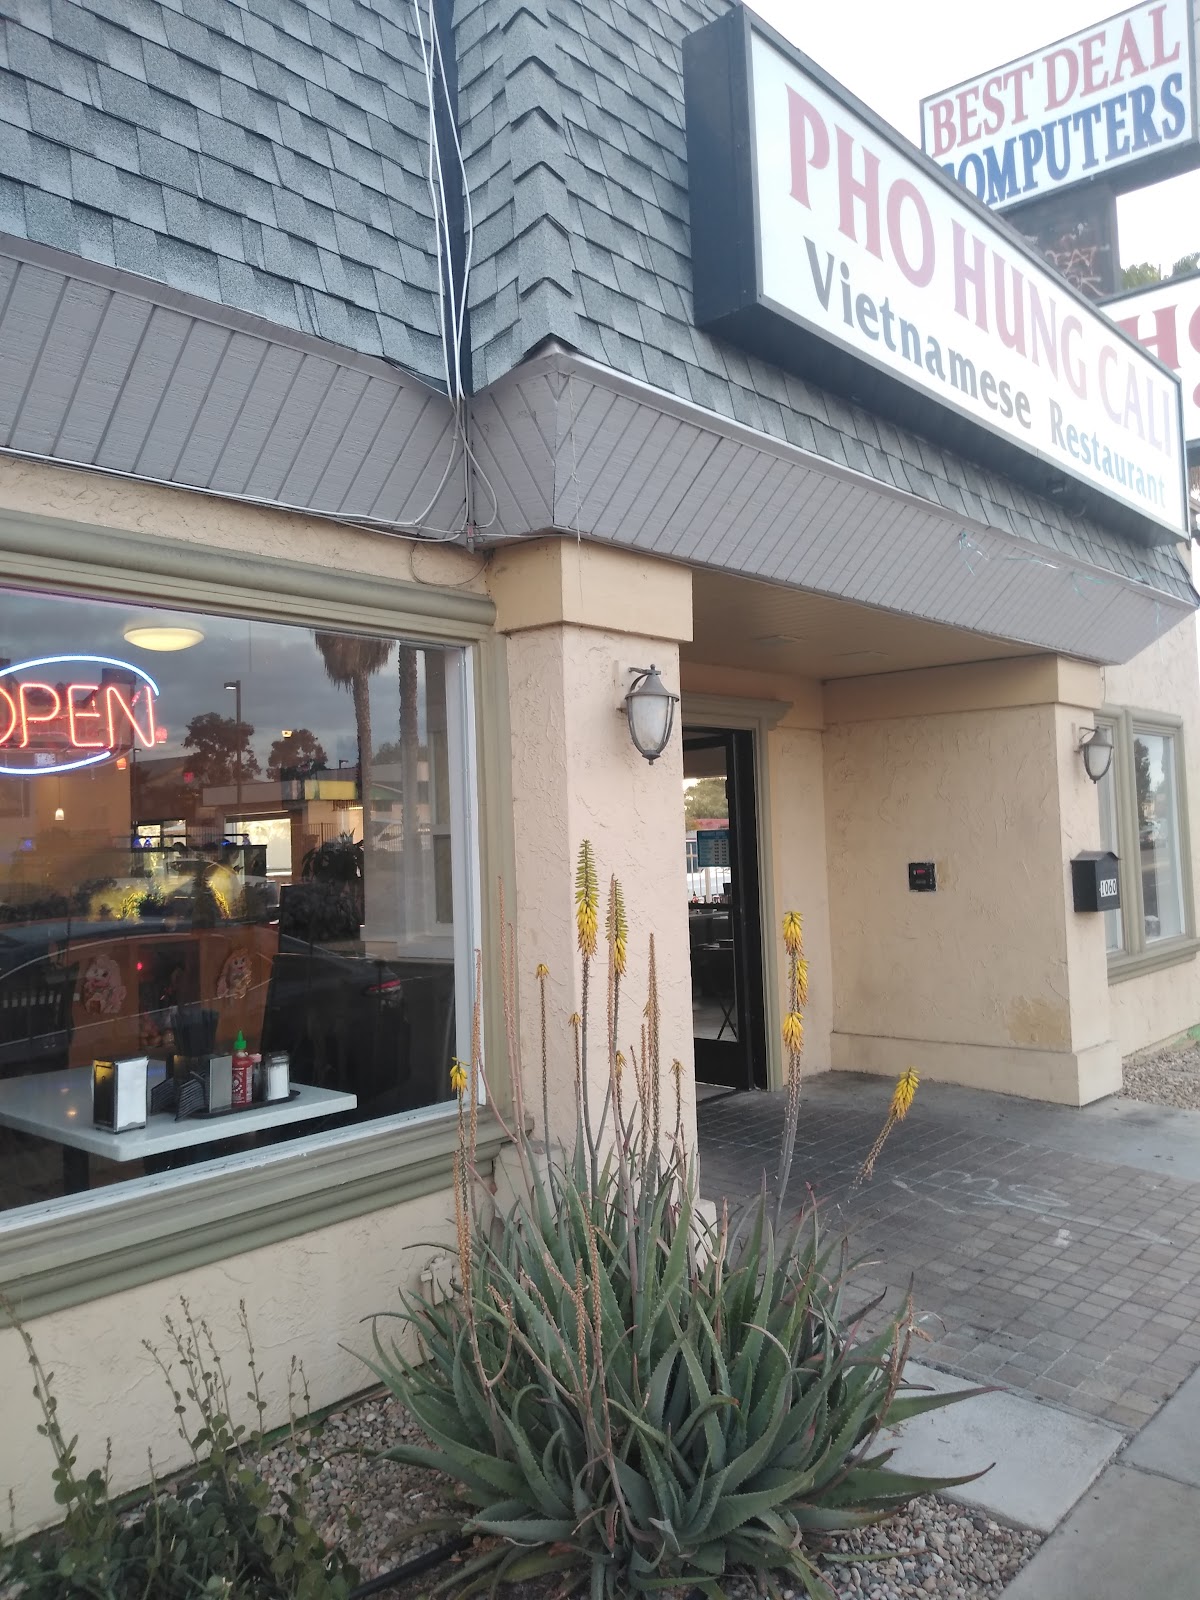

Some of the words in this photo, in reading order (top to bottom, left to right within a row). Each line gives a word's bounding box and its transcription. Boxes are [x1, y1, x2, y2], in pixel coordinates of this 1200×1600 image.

[928, 63, 1034, 158] BEST
[1041, 3, 1181, 112] DEAL
[784, 82, 936, 288] PHO
[950, 217, 1088, 401] HUNG
[1098, 344, 1172, 458] CALI
[803, 235, 1032, 430] Vietnamese
[1049, 397, 1166, 508] Restaurant
[1101, 880, 1117, 896] 1060
